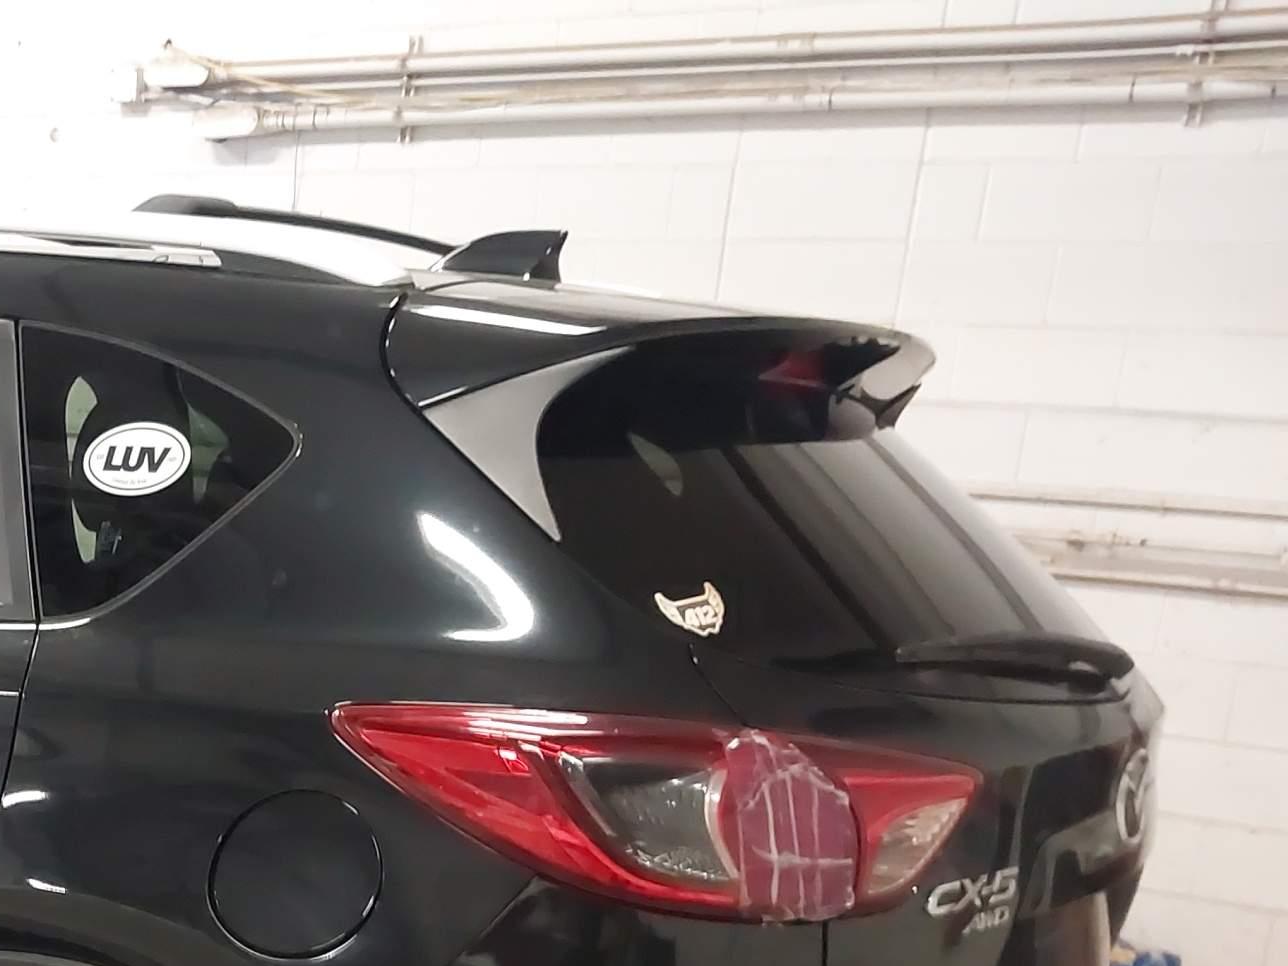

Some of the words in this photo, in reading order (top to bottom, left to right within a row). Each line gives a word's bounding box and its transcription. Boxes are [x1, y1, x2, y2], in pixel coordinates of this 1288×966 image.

[102, 445, 172, 473] LUV
[927, 866, 1019, 914] CX-5
[962, 906, 1010, 935] AWD
